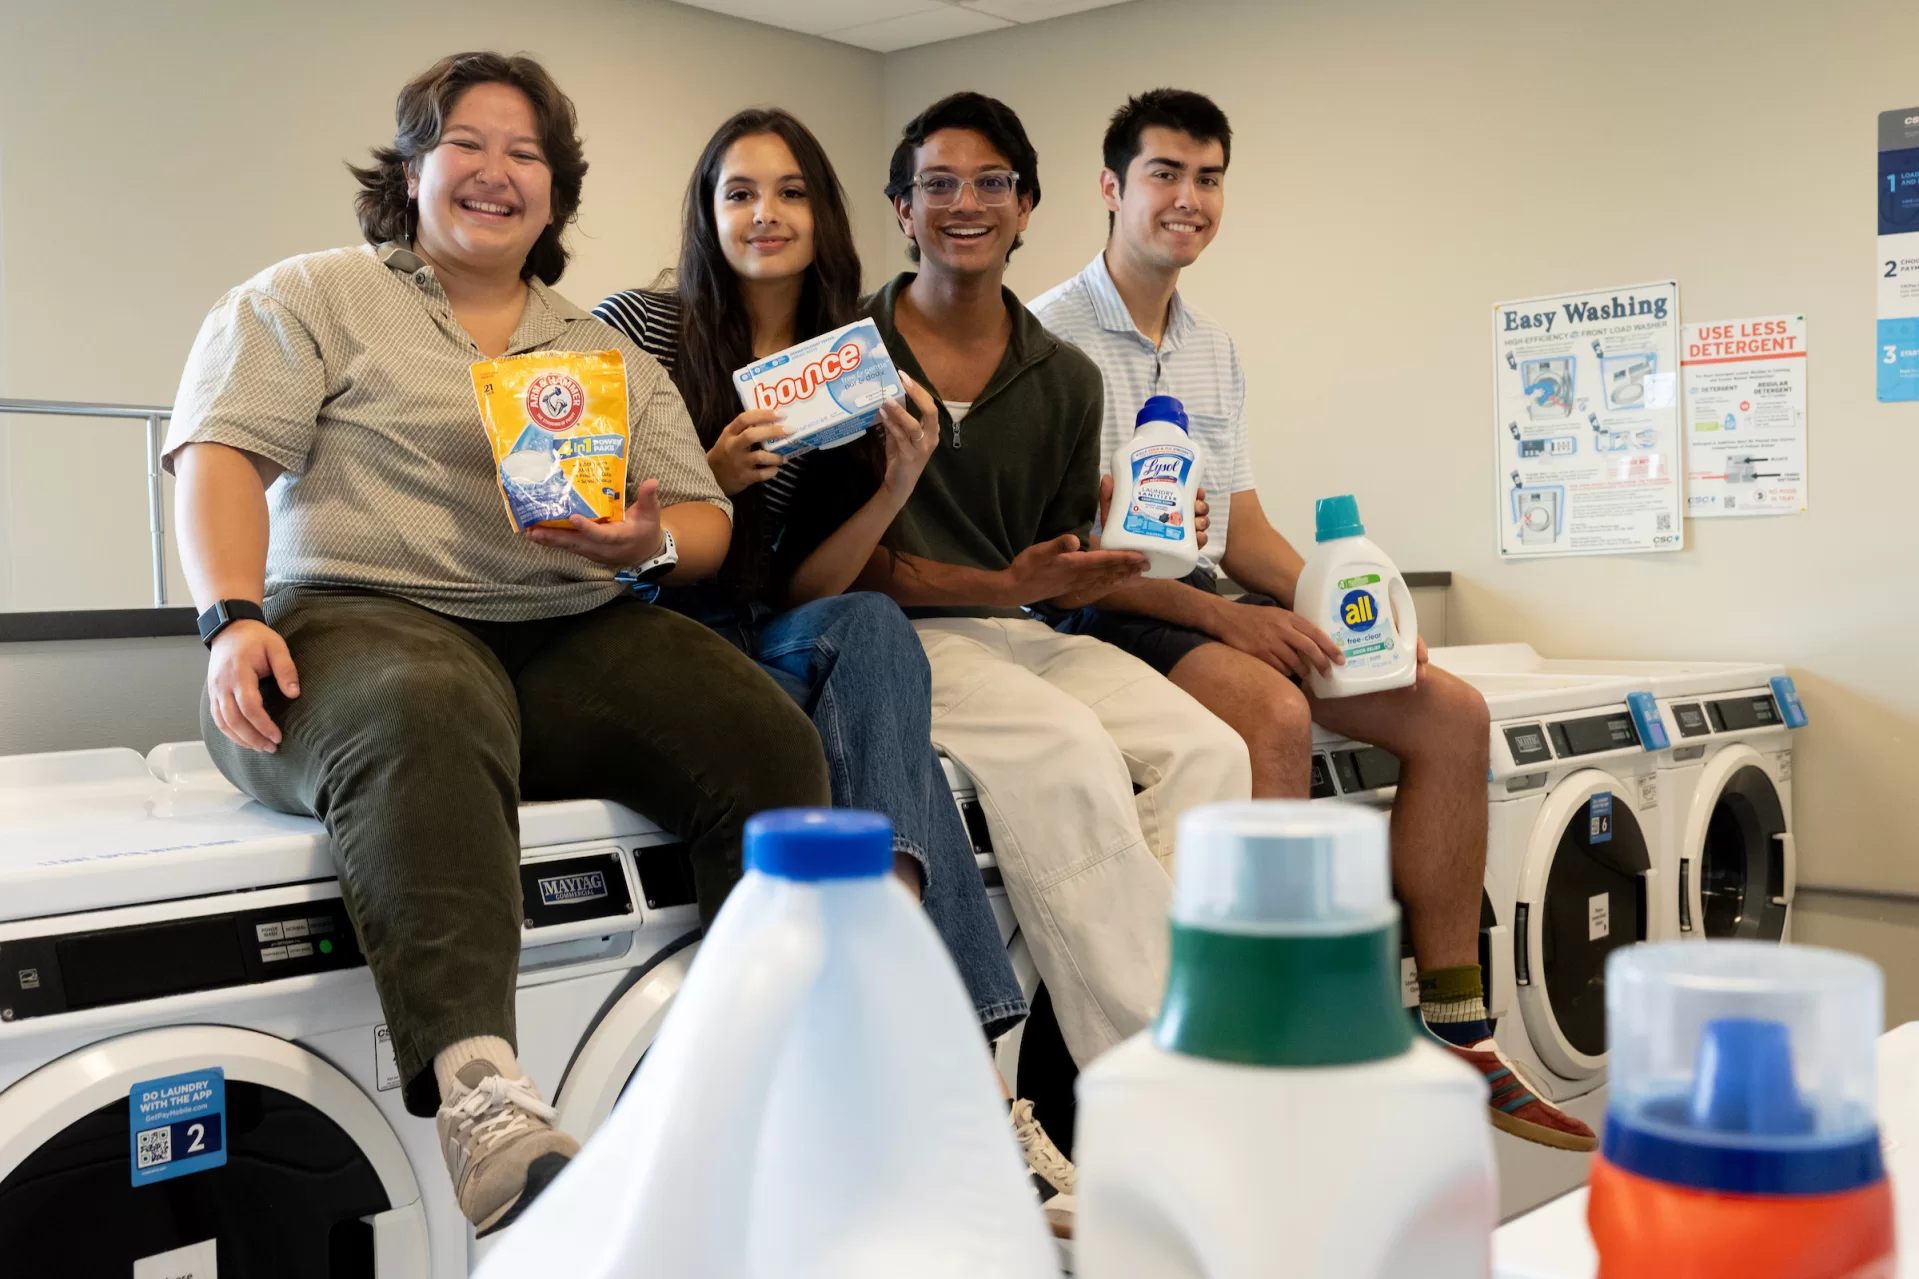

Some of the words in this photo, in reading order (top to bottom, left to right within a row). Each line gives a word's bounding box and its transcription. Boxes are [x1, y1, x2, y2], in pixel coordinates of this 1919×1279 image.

[1887, 173, 1896, 193] 1
[1884, 260, 1897, 278] 2
[1504, 310, 1557, 333] Easy
[1562, 296, 1668, 324] Washing
[1581, 327, 1607, 337] FRONT
[1609, 325, 1632, 334] LOAD
[1633, 320, 1667, 331] WASHER
[1699, 325, 1734, 341] USE
[1741, 320, 1787, 337] LESS
[1689, 336, 1797, 358] DETERGENT
[1883, 344, 1897, 364] 3
[754, 343, 861, 409] bounce
[841, 375, 856, 384] free
[863, 362, 888, 375] gentle
[844, 381, 856, 390] pur
[865, 370, 885, 381] doux
[484, 384, 493, 392] 21
[530, 384, 541, 408] ARM
[539, 378, 547, 387] &
[547, 375, 580, 406] HAMMER
[1753, 387, 1792, 395] DETERGENT
[1143, 458, 1180, 477] Lysol
[1138, 491, 1176, 501] SANITIZER
[1142, 487, 1174, 497] LAUNDRY
[1653, 536, 1673, 544] CSC
[1345, 595, 1373, 625] all
[1602, 817, 1607, 832] 6
[543, 875, 602, 896] MAYTAG
[556, 889, 594, 900] COMMERCIAL
[140, 1100, 168, 1113] WITH
[170, 1094, 190, 1106] THE
[192, 1089, 212, 1101] APP
[143, 1091, 158, 1102] DO
[161, 1080, 209, 1098] LAUNDRY
[145, 1103, 208, 1122] GetPayMobile.com
[187, 1123, 205, 1153] 2
